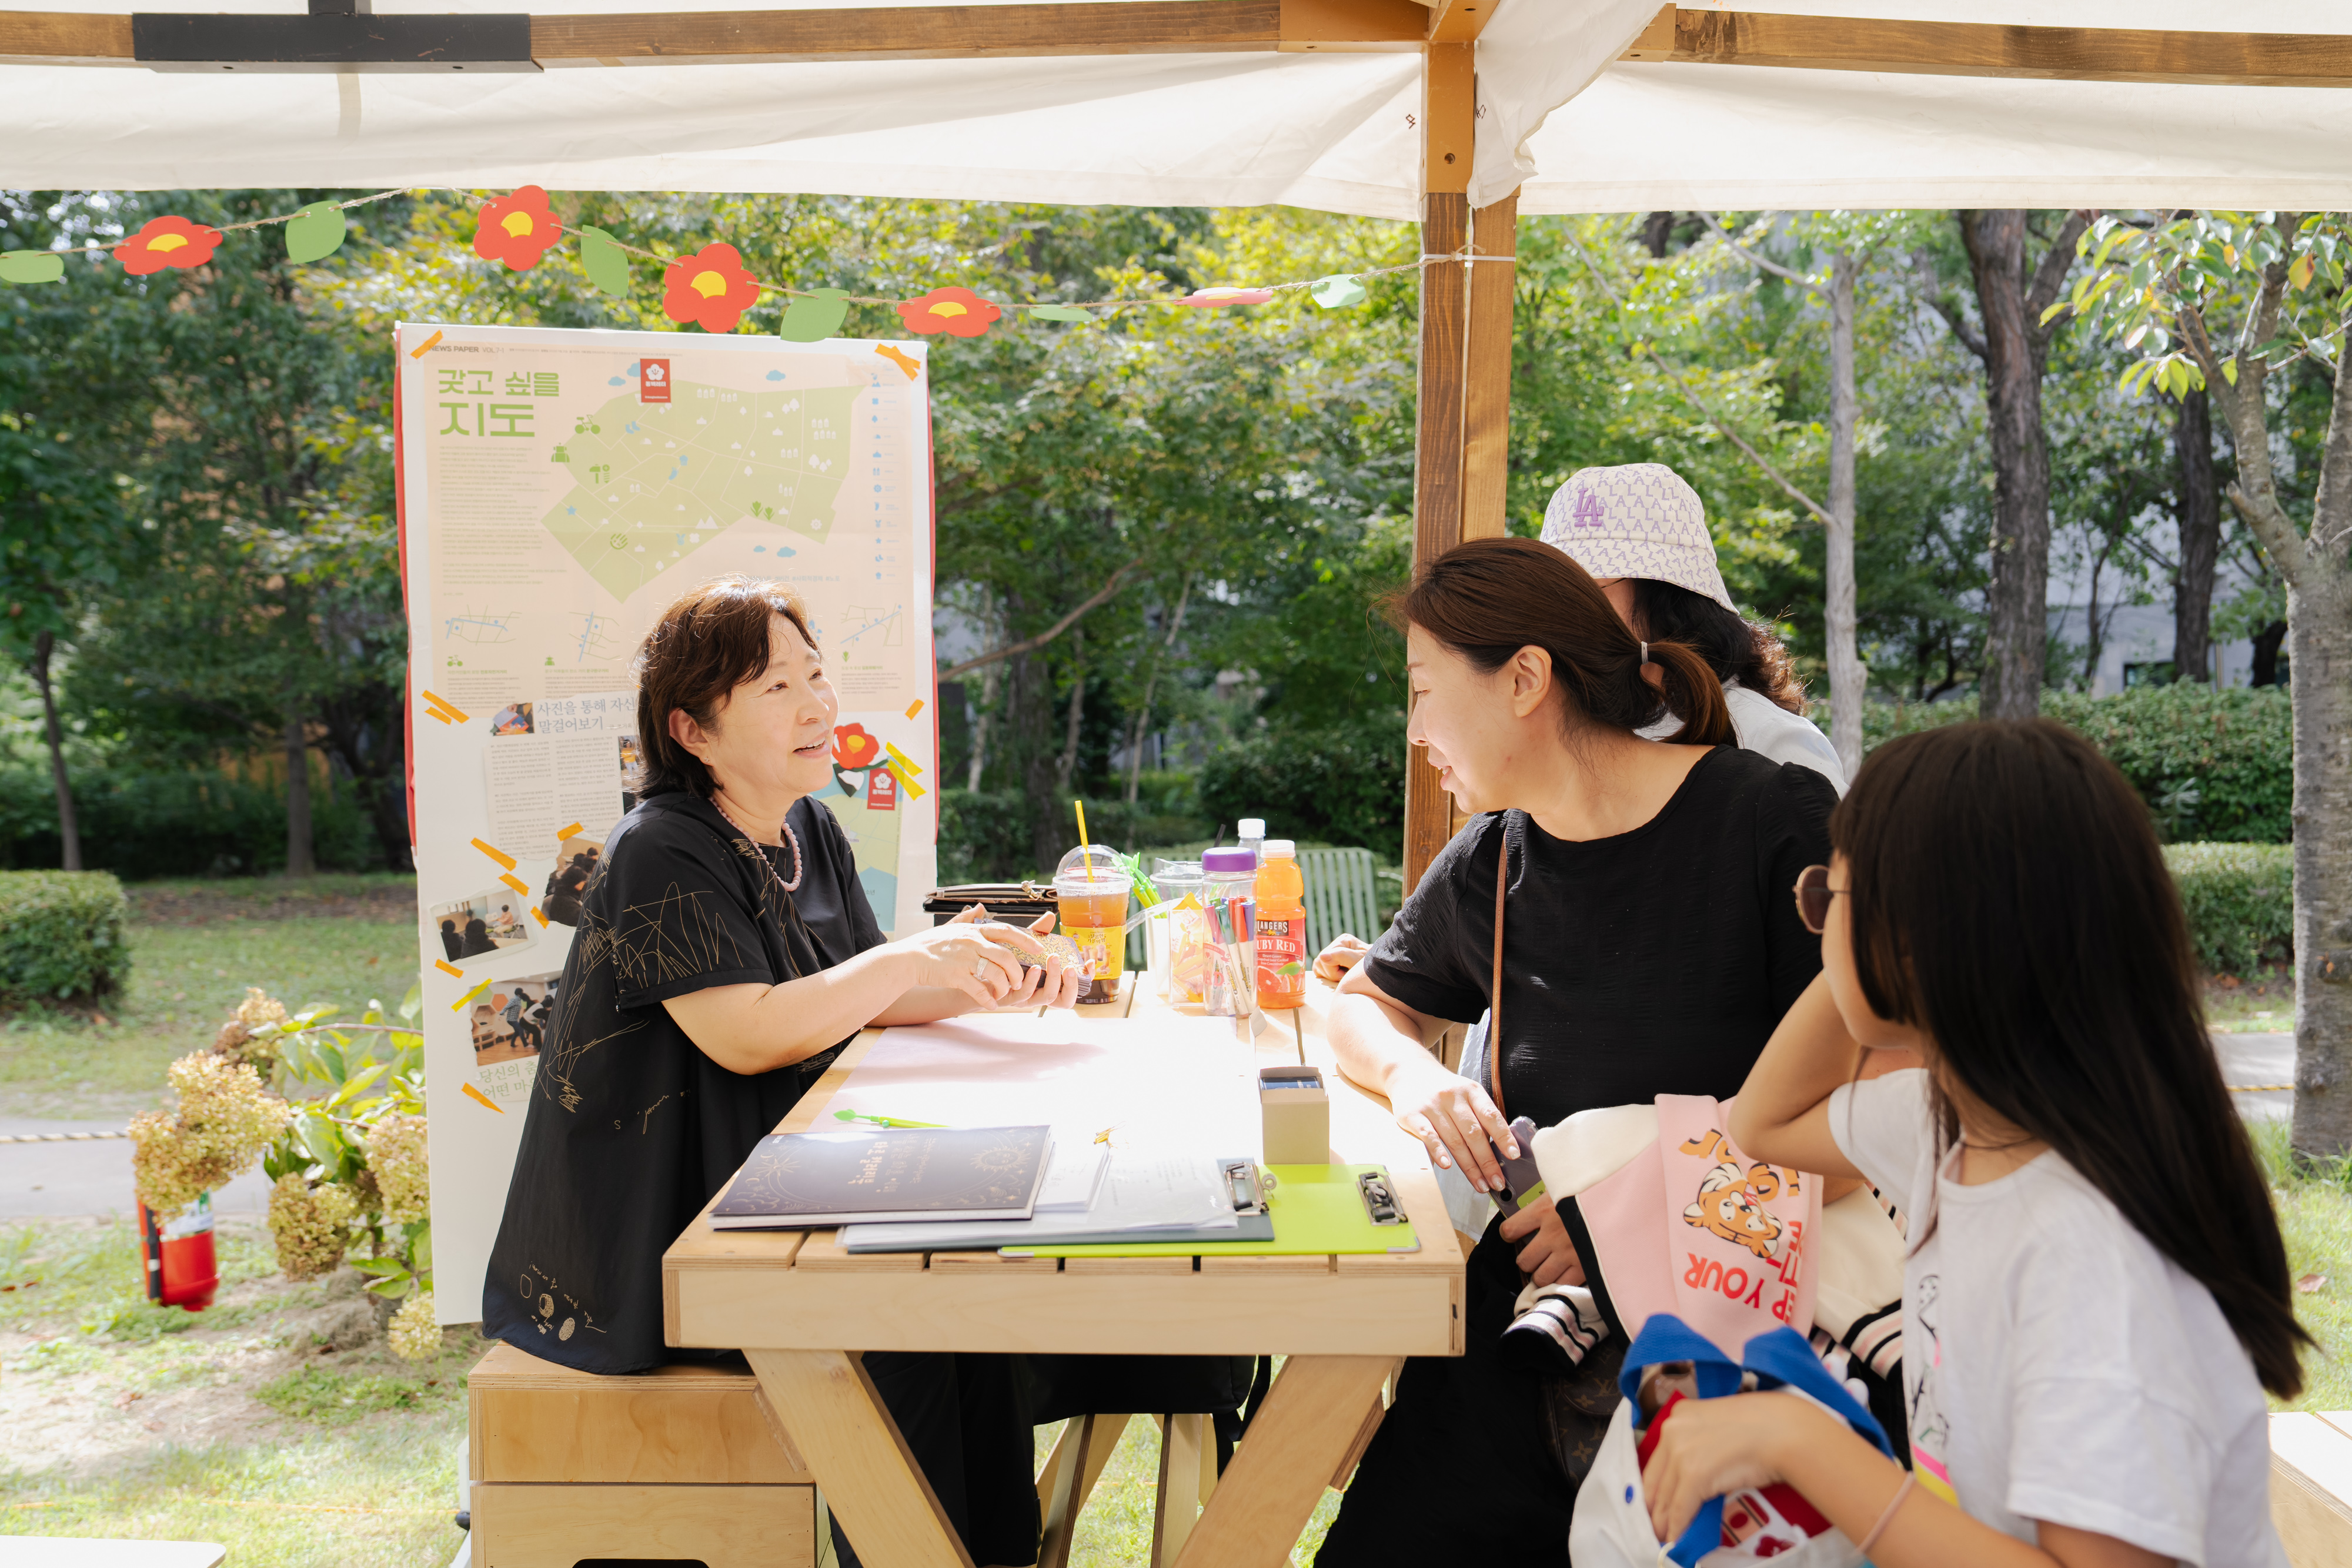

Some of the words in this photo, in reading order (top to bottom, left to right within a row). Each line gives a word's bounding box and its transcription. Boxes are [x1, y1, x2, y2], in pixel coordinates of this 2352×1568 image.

[438, 369, 494, 395] 갖고
[505, 371, 559, 397] 싶을
[439, 402, 535, 437] 지도
[1572, 487, 1604, 527] LA
[537, 700, 577, 717] 사진을
[580, 697, 606, 714] 통해
[539, 716, 603, 734] 말걸어보기
[1257, 921, 1288, 933] LANGERS
[1257, 939, 1274, 950] UBY
[1275, 938, 1296, 952] RED
[480, 1063, 520, 1083] 당신의
[483, 1082, 510, 1099] 어떤
[867, 1141, 889, 1155] 타로
[847, 1156, 883, 1185] 컬러링북
[1683, 1252, 1765, 1309] YOUR
